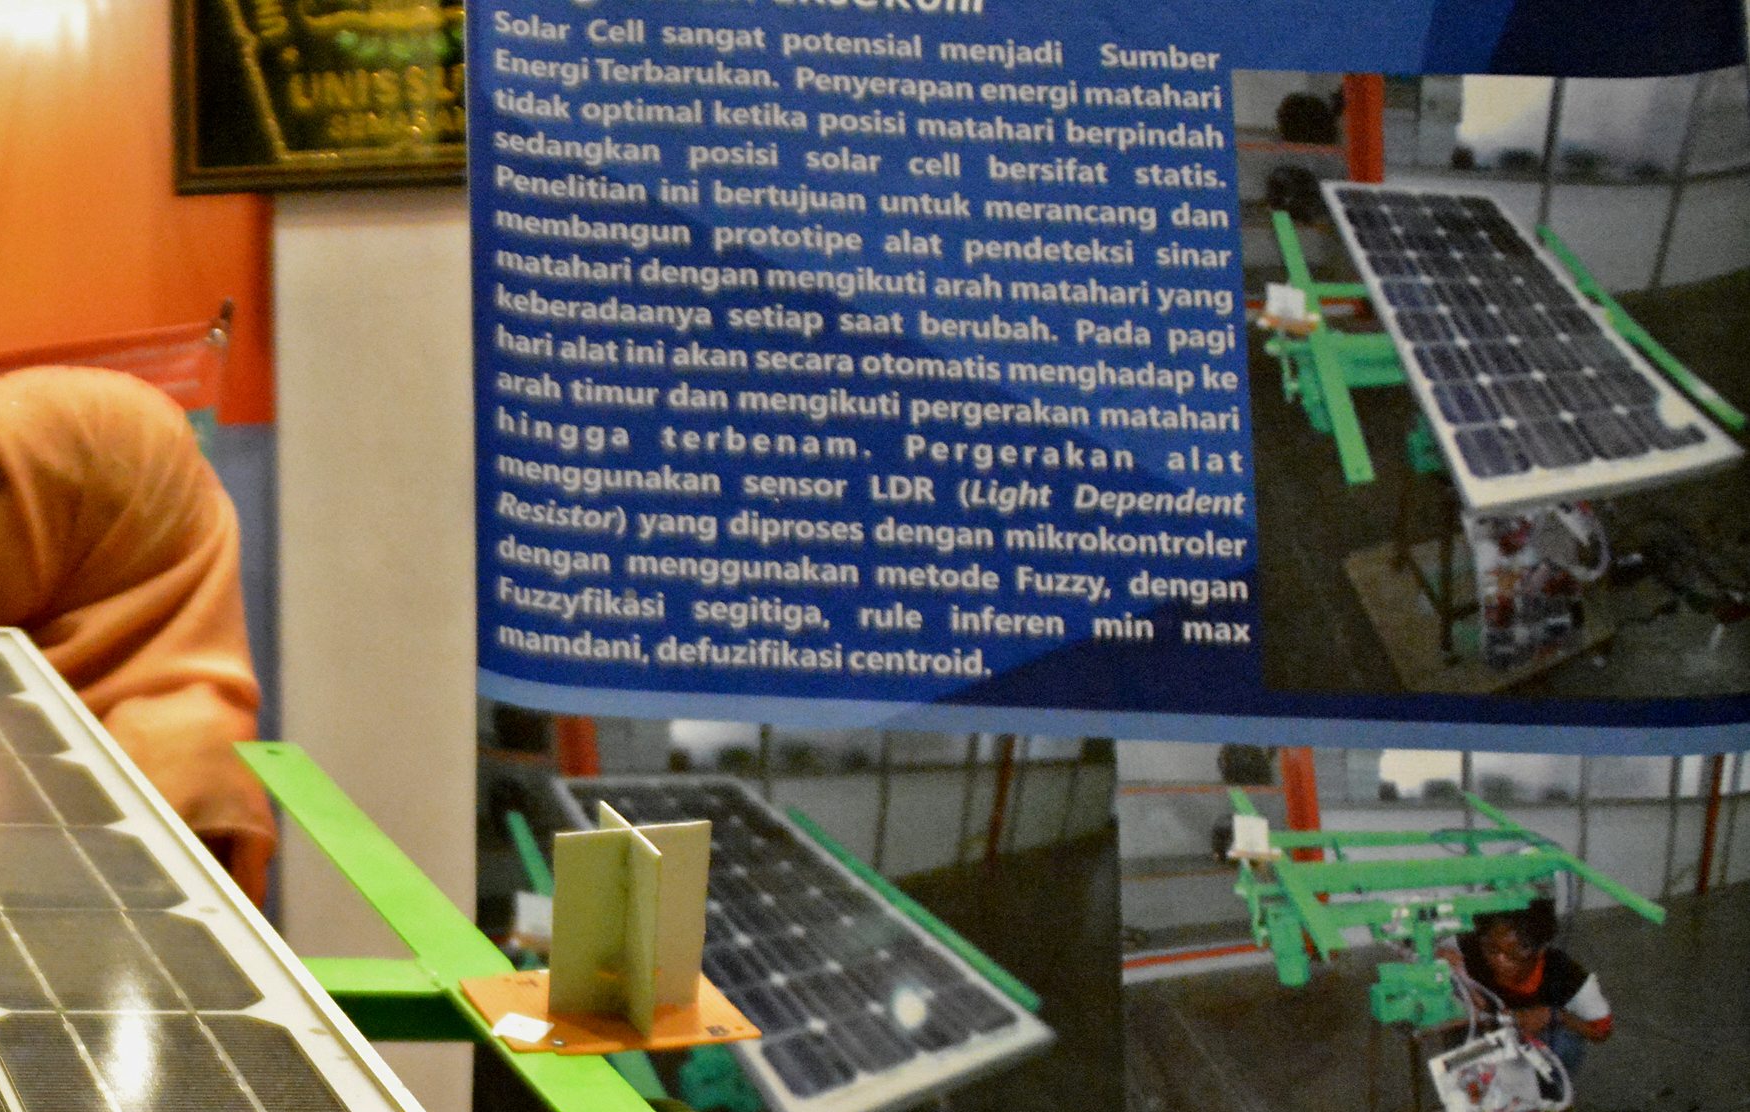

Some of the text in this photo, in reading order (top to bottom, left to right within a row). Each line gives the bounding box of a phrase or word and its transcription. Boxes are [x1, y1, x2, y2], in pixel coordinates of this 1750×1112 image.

[492, 10, 1221, 71] Solar Cell sangat potensial menjadi Sumber
[493, 48, 1222, 111] Energi Terbarukan. Penyerapan energi matahari
[493, 88, 1225, 152] tidak optimal ketika posisi matahari berpindah
[494, 131, 1226, 188] sedangkan posisi solar cell bersifat statis.
[494, 165, 1229, 232] Penelitian ini bertujuan untuk merancang dan
[494, 210, 1232, 268] membangun prototipe alat pendeteksi sinar
[495, 250, 1233, 316] matahari dengan mengikuti arah matahari yang
[495, 284, 1236, 356] keberadaanya setiap saat berubah. Pada pagi
[494, 324, 1239, 395] hari alat ini akan secara otomatis menghadap ke
[495, 372, 1240, 432] arah timur dan mengikuti pergerakan matahari
[495, 406, 1244, 474] hingga terbenam. Pergerakan alat
[495, 455, 1246, 518] menggunakan sensor LDR (Light Dependent
[496, 491, 1247, 558] Resistor) yang diproses dengan mikrokontroler
[496, 535, 1248, 606] dengan menggunakan metode Fuzzy, dengan
[496, 576, 1251, 644] Fuzzyfikasi segitiga, rule inferen min max
[497, 626, 992, 678] mamdani, defuzifikasi centroid.
